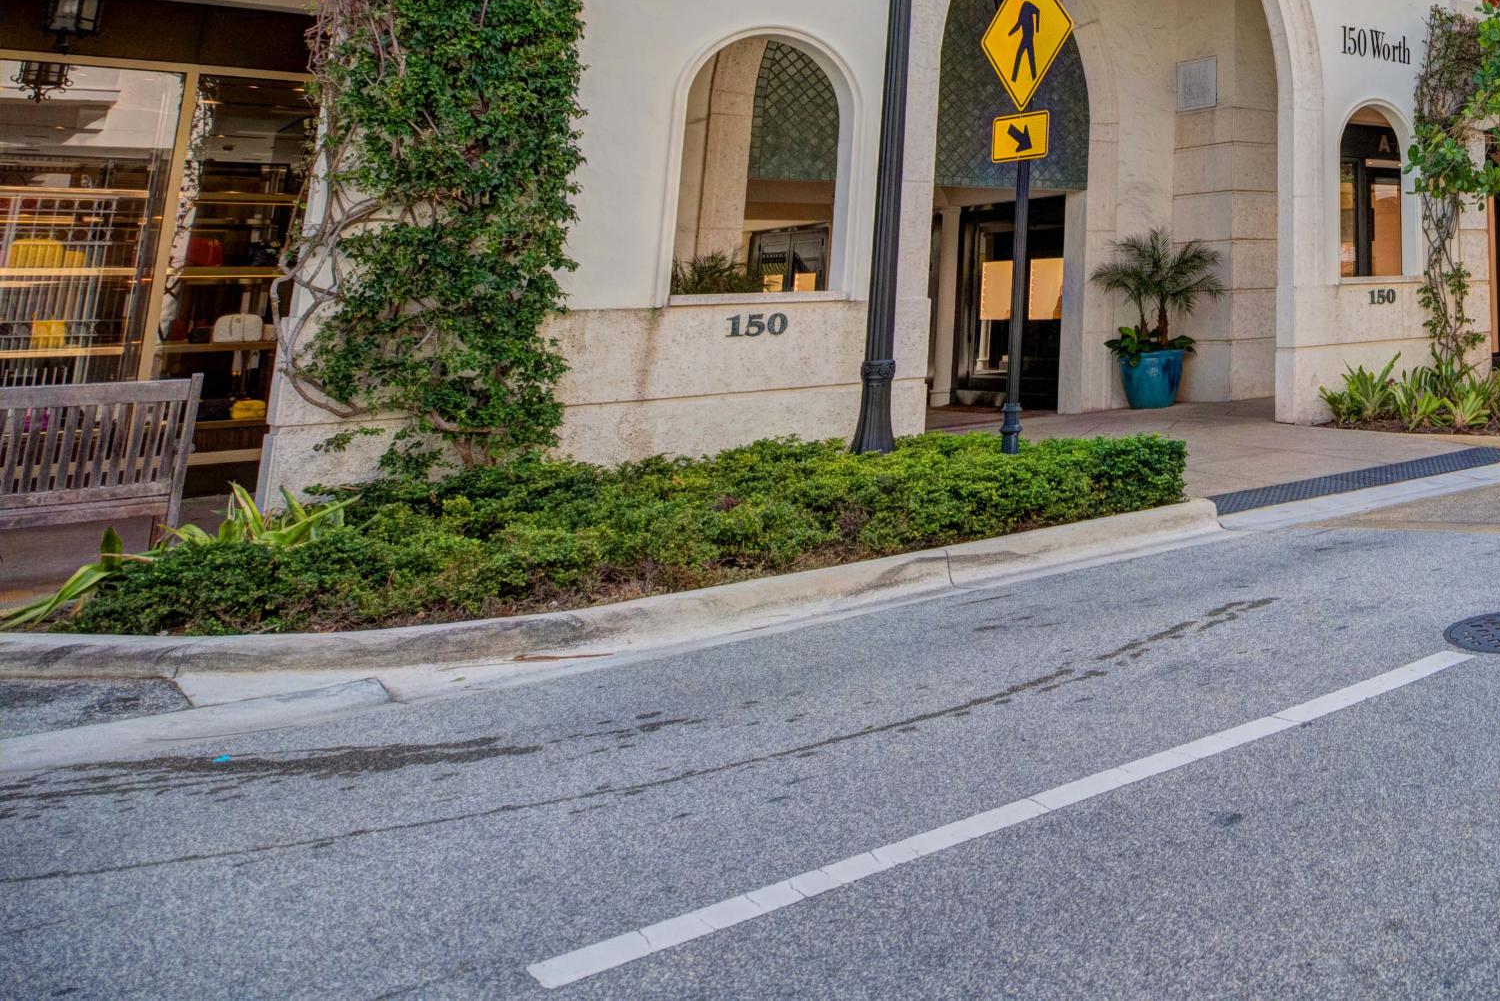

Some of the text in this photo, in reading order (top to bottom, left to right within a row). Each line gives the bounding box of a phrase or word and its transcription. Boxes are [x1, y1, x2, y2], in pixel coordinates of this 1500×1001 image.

[1341, 25, 1411, 65] 150 Worth
[1368, 288, 1397, 305] 150
[725, 312, 788, 338] 150
